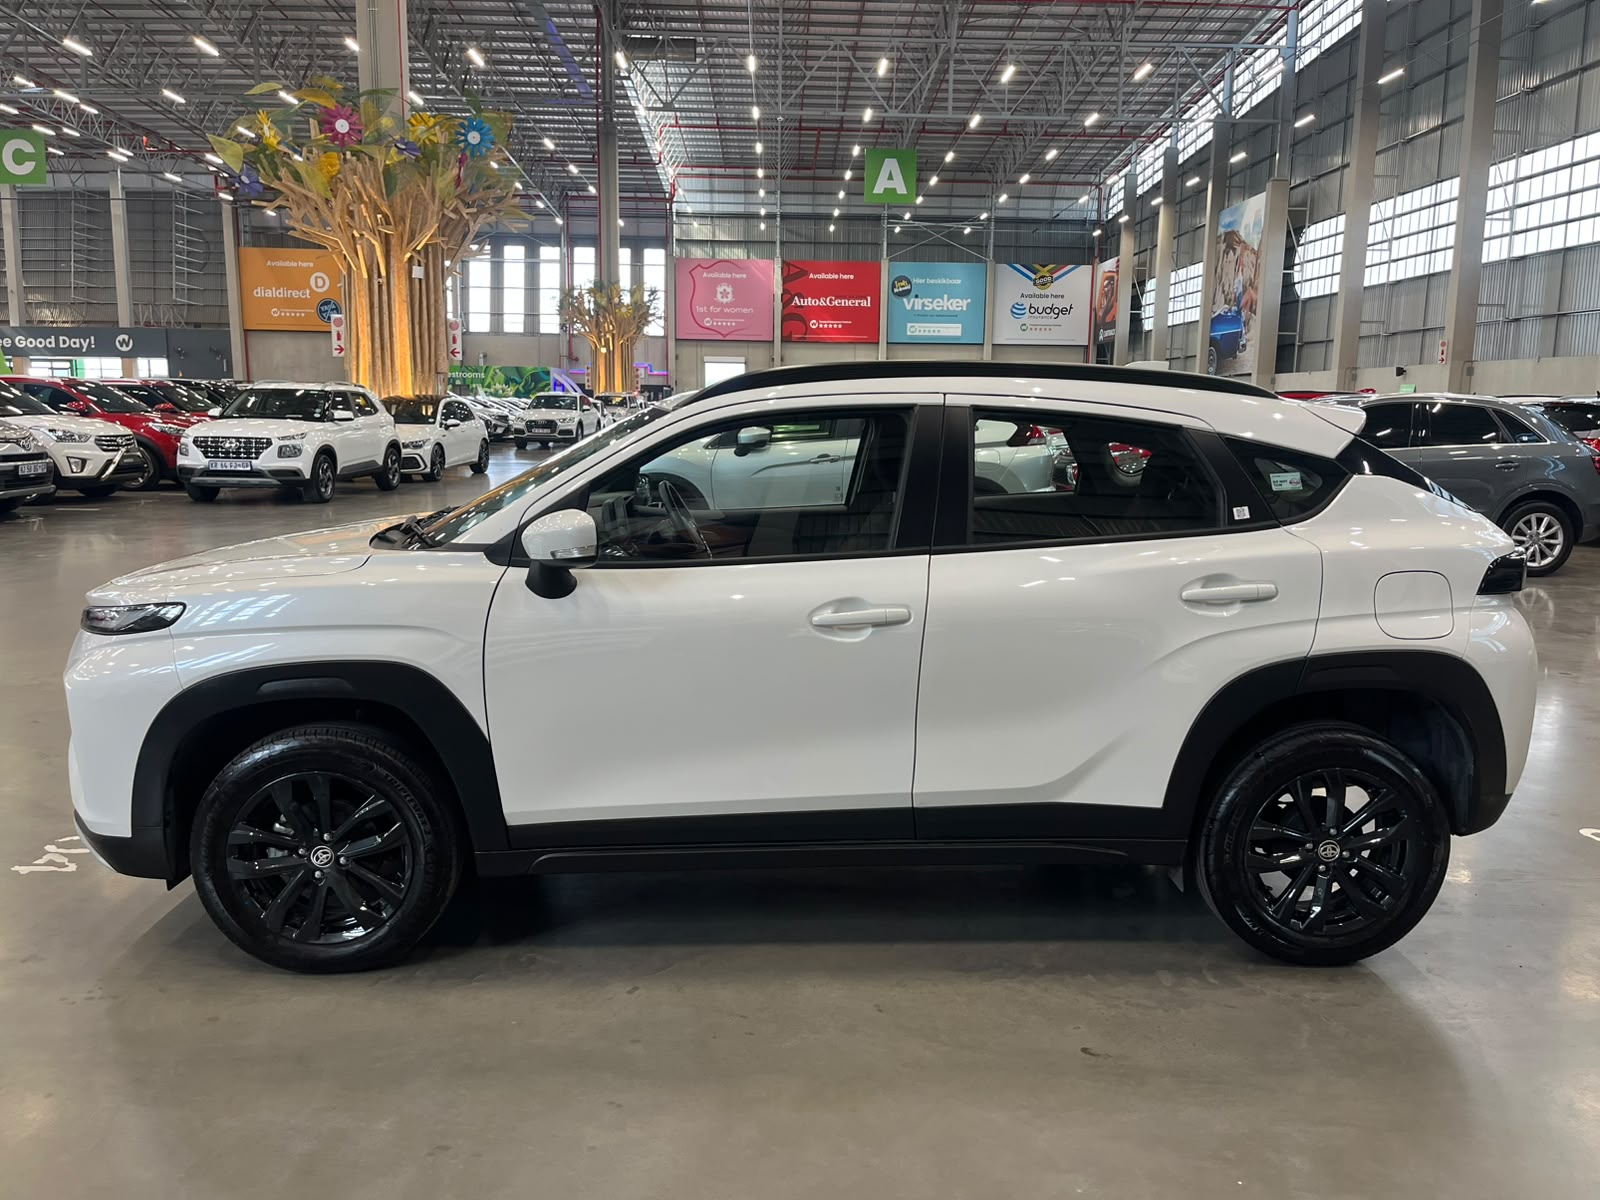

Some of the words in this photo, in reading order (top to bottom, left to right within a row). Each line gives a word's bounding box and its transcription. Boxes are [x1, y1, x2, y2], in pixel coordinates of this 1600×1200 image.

[2, 138, 36, 175] C
[872, 158, 908, 194] A
[298, 260, 314, 268] here
[839, 272, 855, 280] here
[253, 286, 311, 299] dialdirect
[1050, 292, 1065, 300] here
[791, 295, 871, 307] Auto&General
[902, 293, 971, 311] virseker
[695, 305, 708, 313] 1st
[709, 305, 721, 313] for
[1028, 303, 1074, 319] budget
[14, 335, 56, 348] Good
[59, 335, 96, 352] Day!
